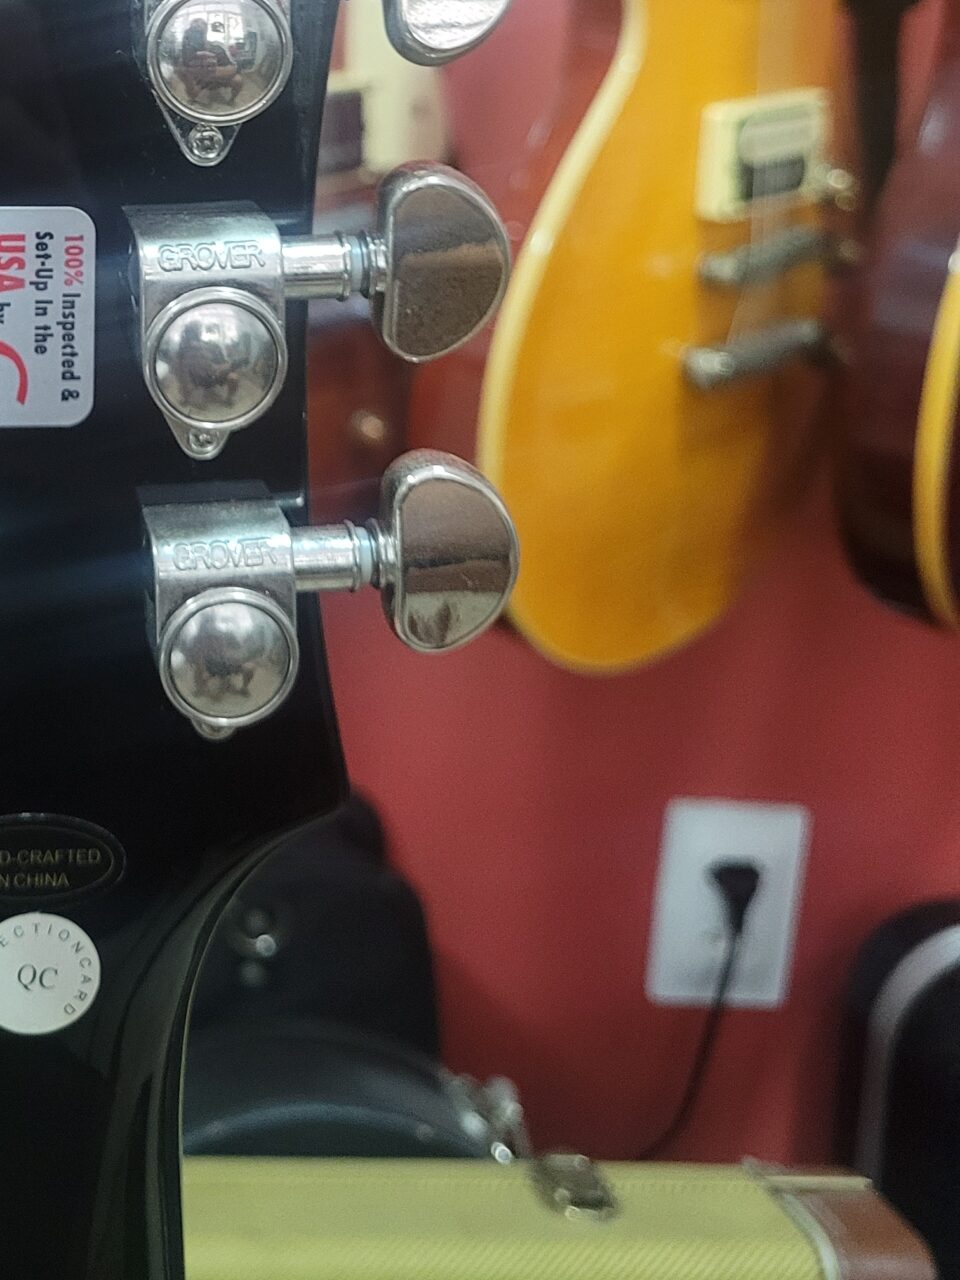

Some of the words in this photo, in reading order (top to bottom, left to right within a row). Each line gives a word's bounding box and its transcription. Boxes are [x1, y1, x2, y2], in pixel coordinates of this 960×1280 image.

[29, 231, 54, 292] Set-Up
[64, 234, 85, 287] 100%
[158, 239, 267, 272] GROVER
[34, 299, 54, 317] In
[34, 325, 54, 356] the
[56, 293, 82, 382] Inspected
[60, 388, 81, 402] &
[172, 536, 278, 571] GROVER
[13, 871, 71, 889] CHINA
[16, 963, 59, 992] QC
